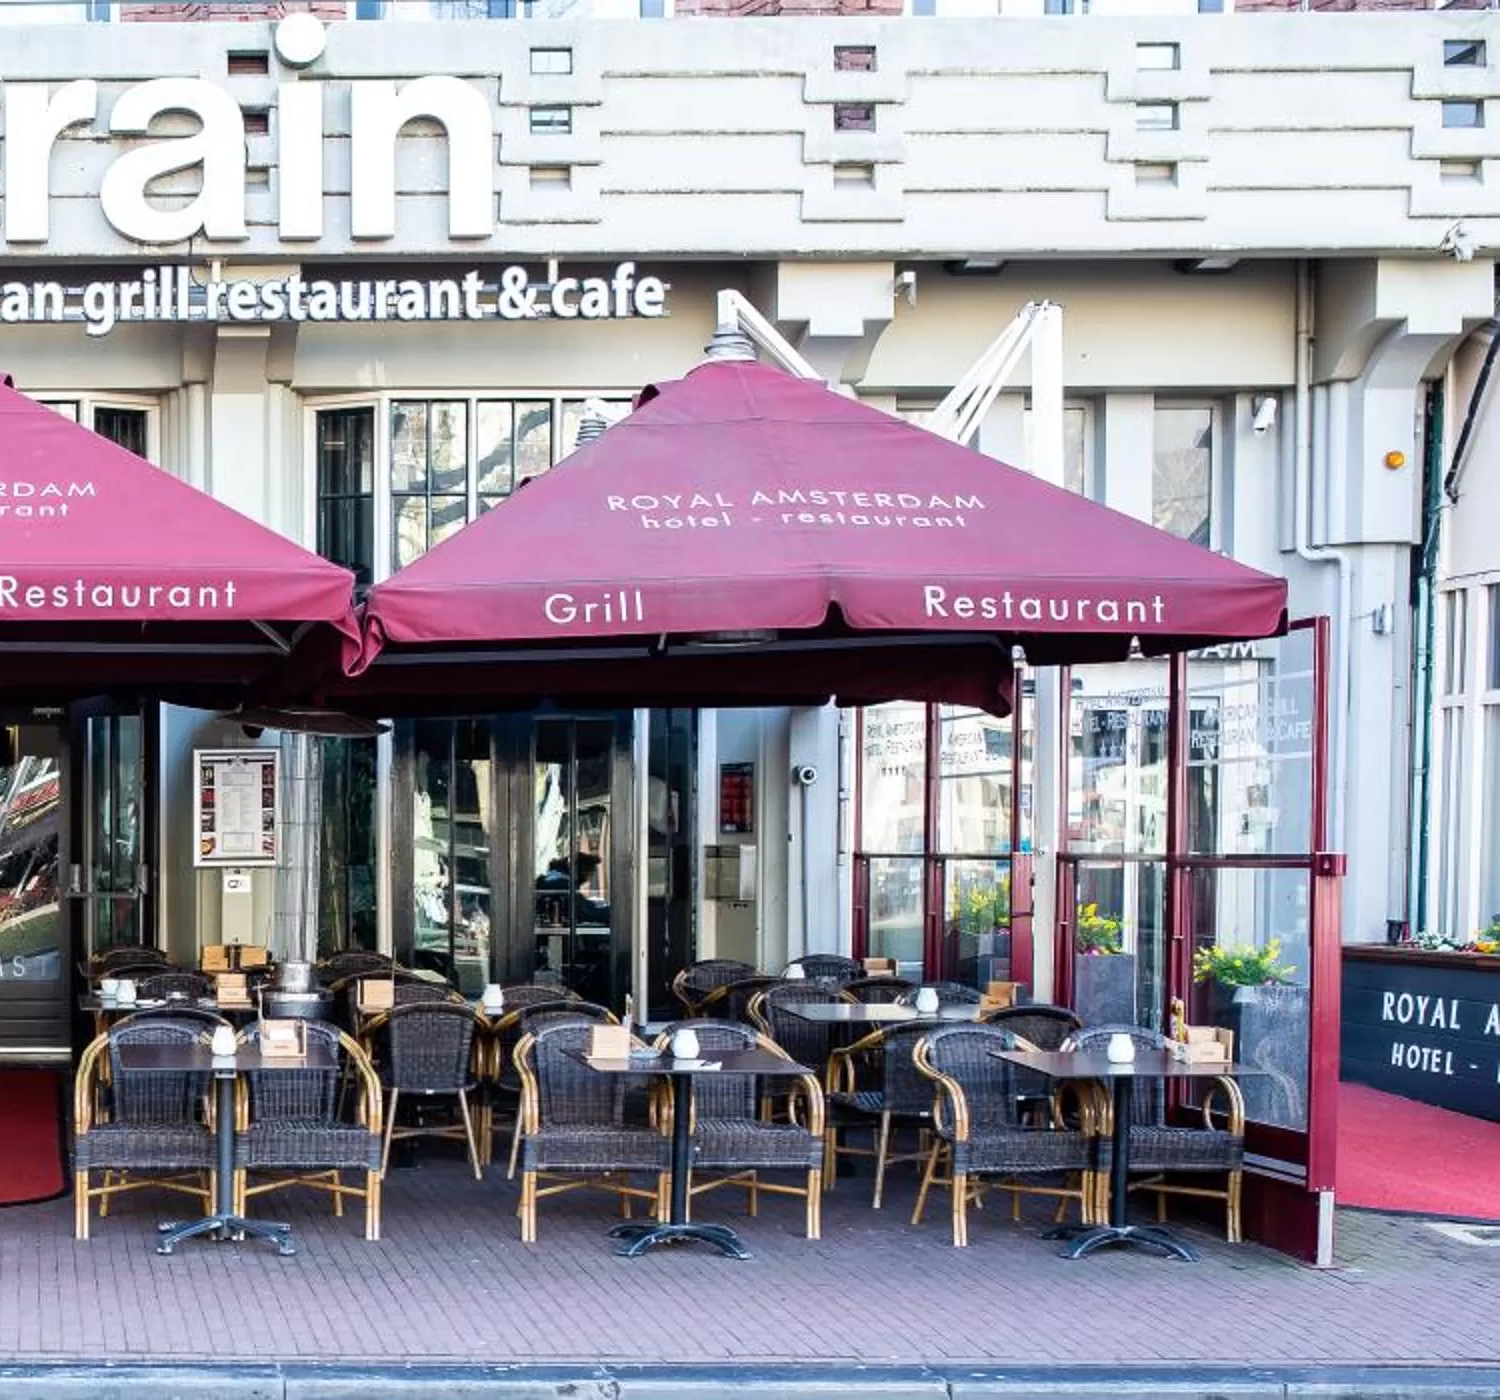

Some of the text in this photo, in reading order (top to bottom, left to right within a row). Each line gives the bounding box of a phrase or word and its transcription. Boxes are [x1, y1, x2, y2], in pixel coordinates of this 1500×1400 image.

[5, 12, 493, 245] rain
[83, 265, 189, 336] grill
[206, 269, 482, 322] restaurant
[499, 265, 538, 320] &
[551, 261, 665, 319] cafe
[606, 488, 986, 512] ROYAL AMSTERDAM
[640, 511, 733, 530] hotel
[780, 510, 967, 529] restaurant
[544, 590, 645, 625] Grill
[923, 584, 1166, 624] Restaurant
[1381, 990, 1462, 1031] ROYAL
[1390, 1041, 1455, 1076] HOTEL
